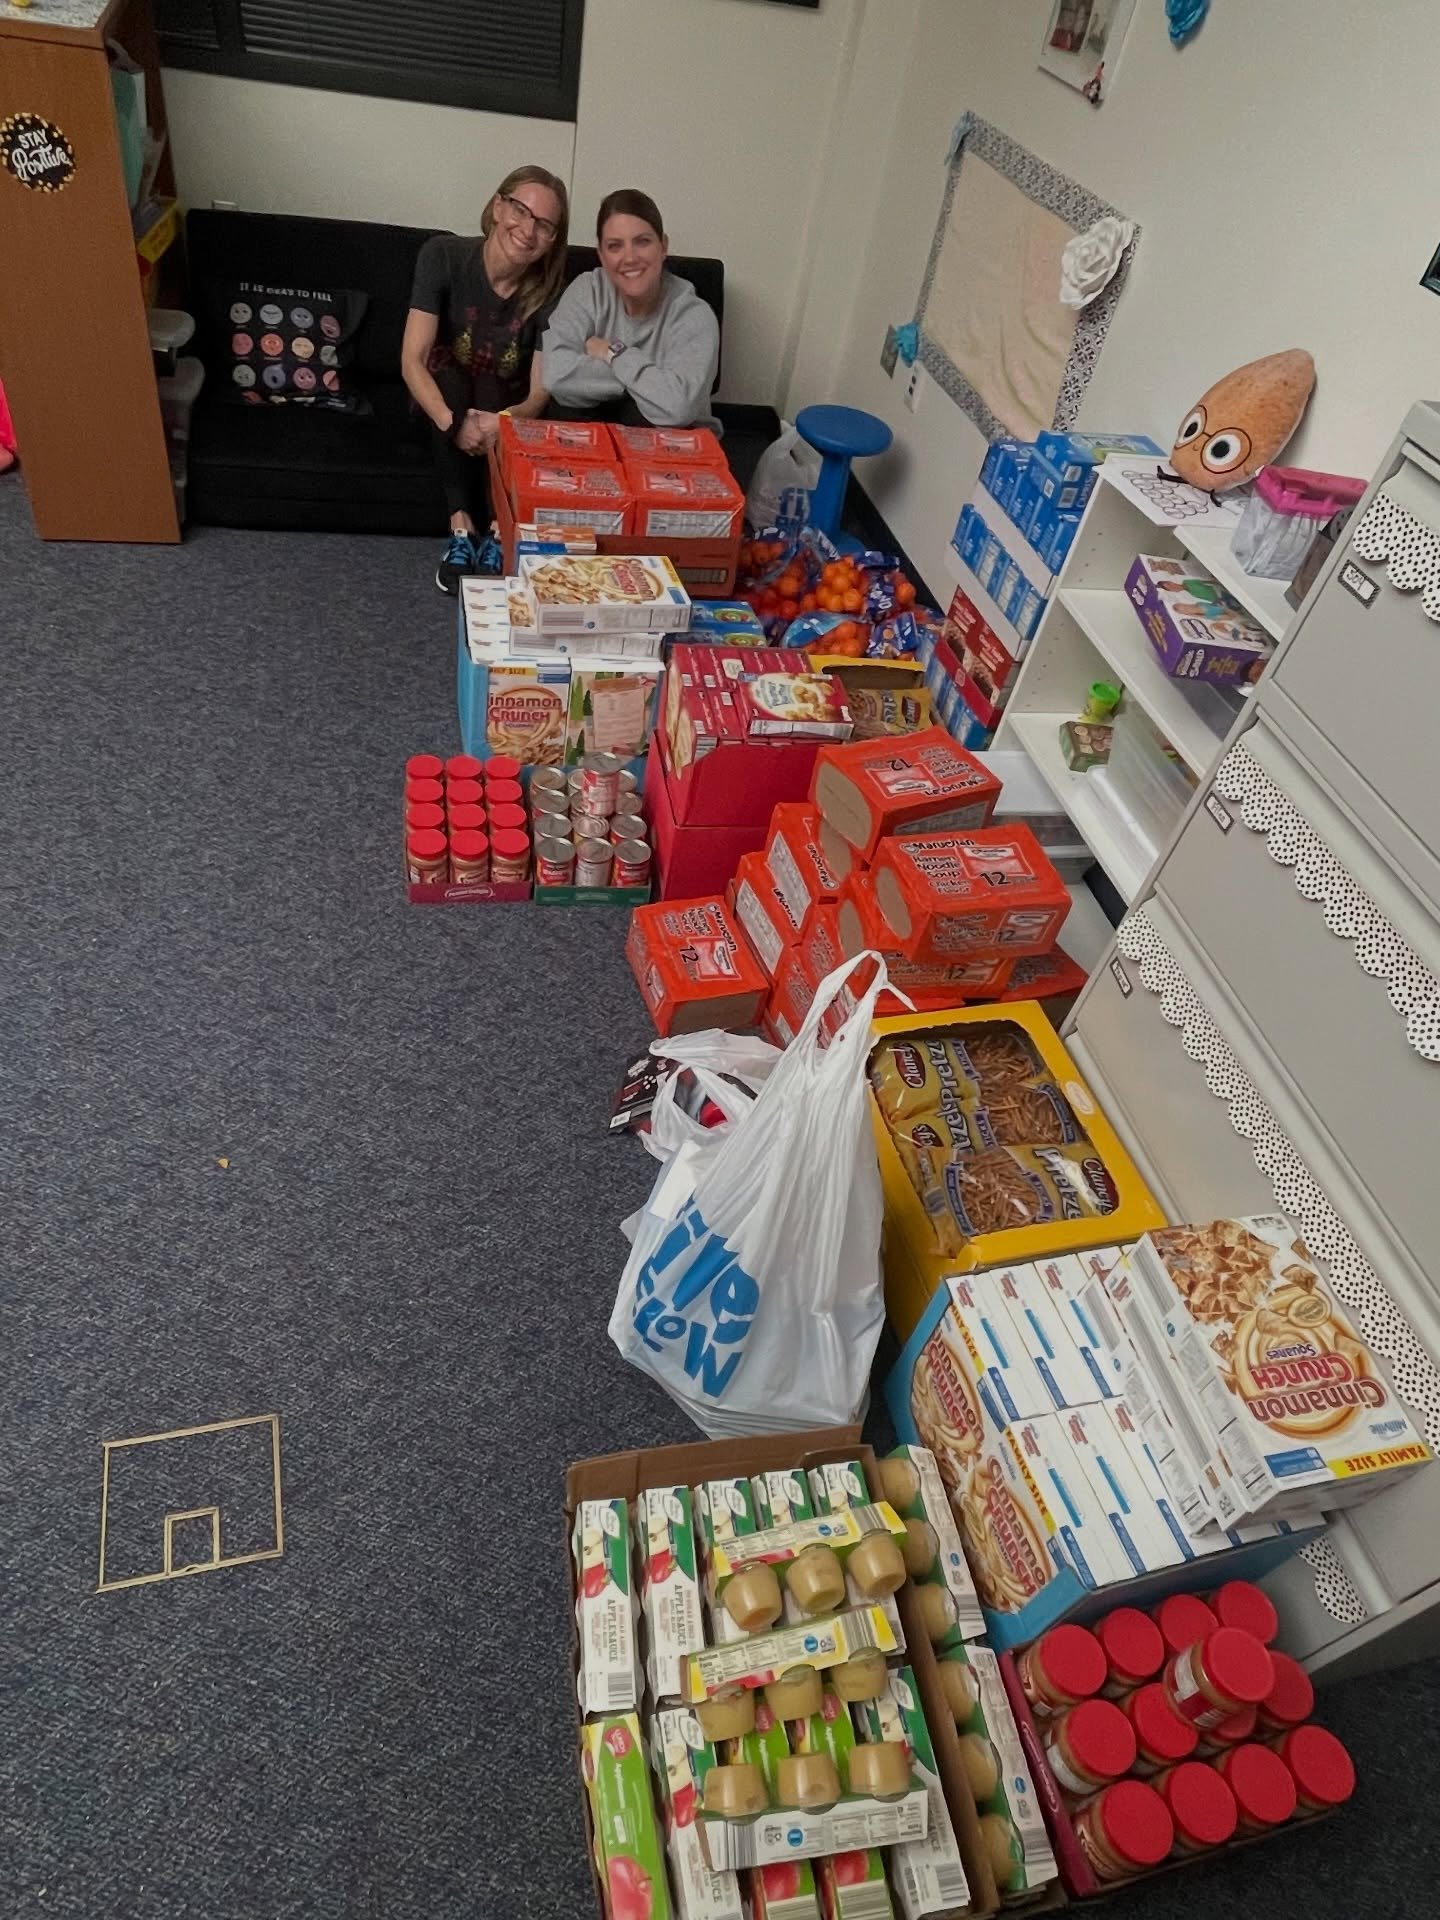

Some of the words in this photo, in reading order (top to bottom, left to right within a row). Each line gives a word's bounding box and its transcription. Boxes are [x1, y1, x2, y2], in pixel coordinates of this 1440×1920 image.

[18, 128, 49, 149] STAY
[12, 144, 70, 181] Positive
[490, 693, 563, 707] innamon
[886, 758, 912, 771] 12
[913, 839, 975, 851] Maruchan
[917, 862, 961, 871] Noodle
[927, 870, 961, 879] Soup
[980, 871, 1011, 887] 12
[714, 911, 737, 951] Maruchan
[997, 930, 1016, 942] 12
[680, 945, 699, 964] 12
[947, 967, 966, 980] 12
[904, 1045, 925, 1088] Clancy
[925, 1040, 964, 1102] Pretz
[1034, 1148, 1082, 1220] Pretze
[1083, 1158, 1114, 1215] Clancy's
[1266, 1343, 1317, 1361] Squares
[934, 1330, 985, 1444] innamon
[1250, 1357, 1350, 1390] CRUNCH
[1246, 1379, 1387, 1422] Cinnamon
[1347, 1458, 1377, 1472] SIZE
[1376, 1445, 1427, 1467] FAMILY
[1004, 1428, 1032, 1482] FAMILY
[1029, 1481, 1049, 1518] SIZE
[987, 1455, 1047, 1586] Cinnamo
[674, 1583, 687, 1647] APPLESAUCE
[607, 1599, 619, 1663] APPLESAUCE
